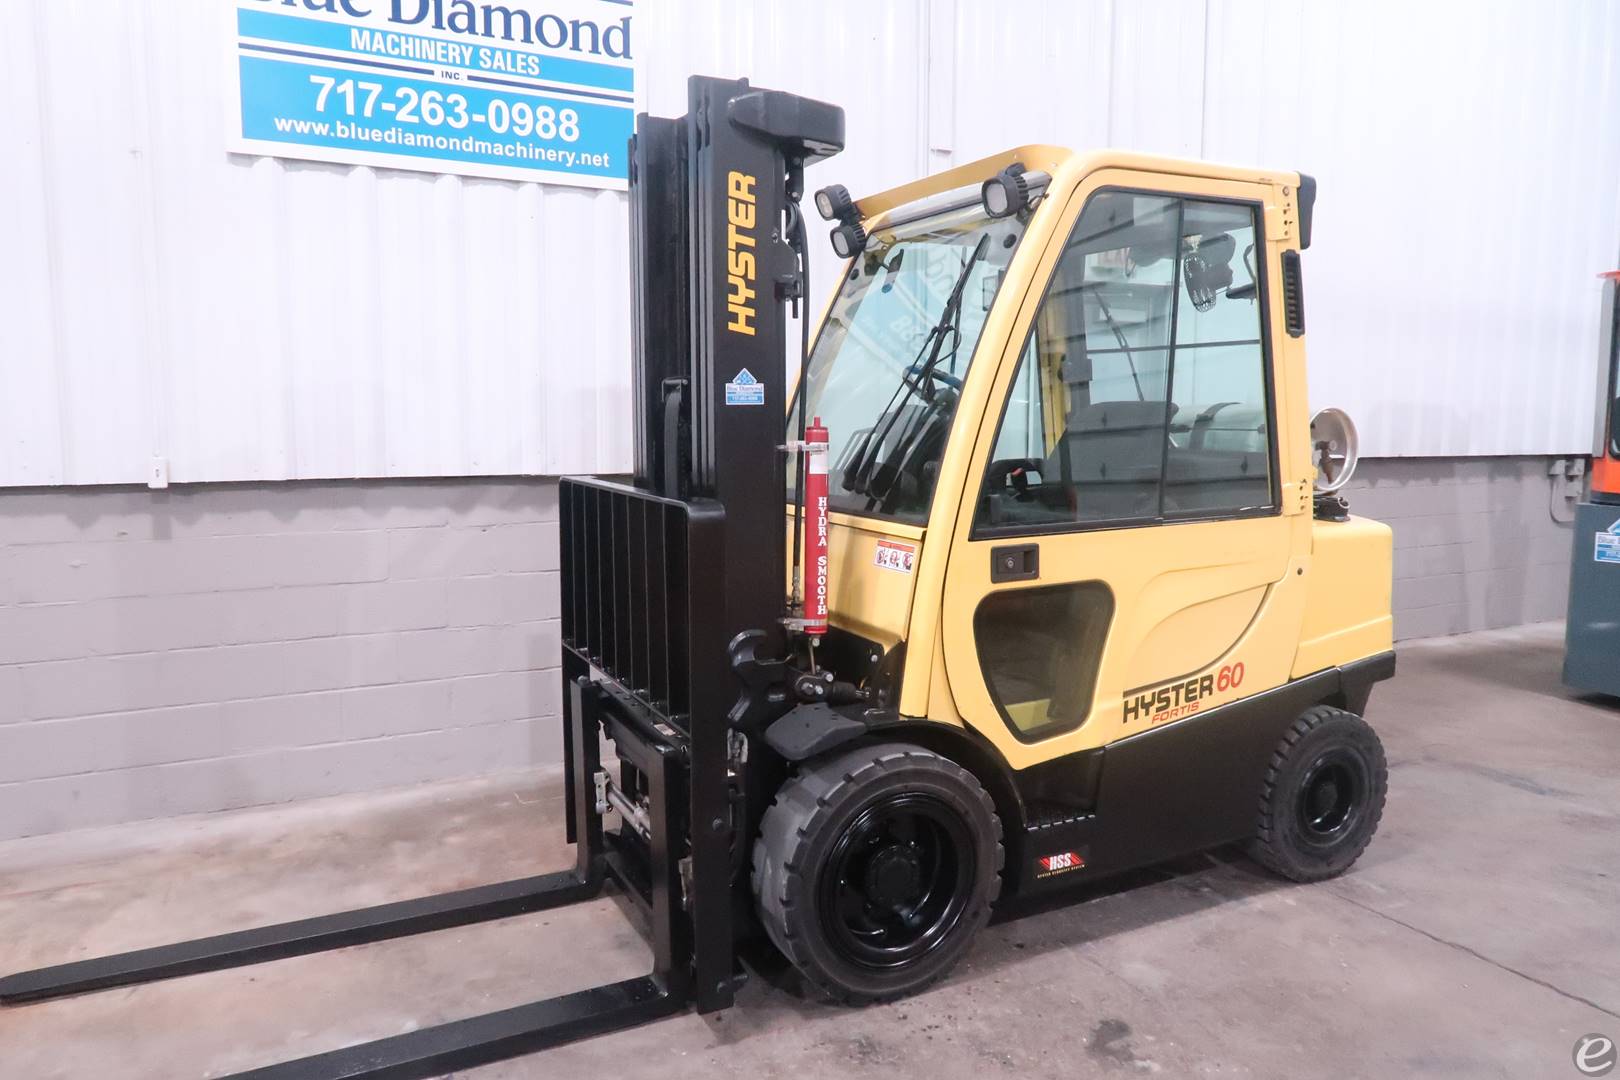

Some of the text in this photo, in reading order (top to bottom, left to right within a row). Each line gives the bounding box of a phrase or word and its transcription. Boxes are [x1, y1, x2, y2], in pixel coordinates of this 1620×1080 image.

[350, 28, 540, 76] MACHINERY SALES
[388, 0, 632, 60] Diamond
[441, 70, 463, 81] INC.
[309, 74, 580, 142] 717-263-0988
[274, 115, 610, 168] www.bluediamondmachinery.net
[727, 170, 756, 336] HYSTER
[817, 497, 828, 615] HYDRA SMOOTH
[1123, 662, 1245, 724] HYSTER 60
[1152, 702, 1200, 725] FORTIS
[1049, 852, 1072, 871] HSS
